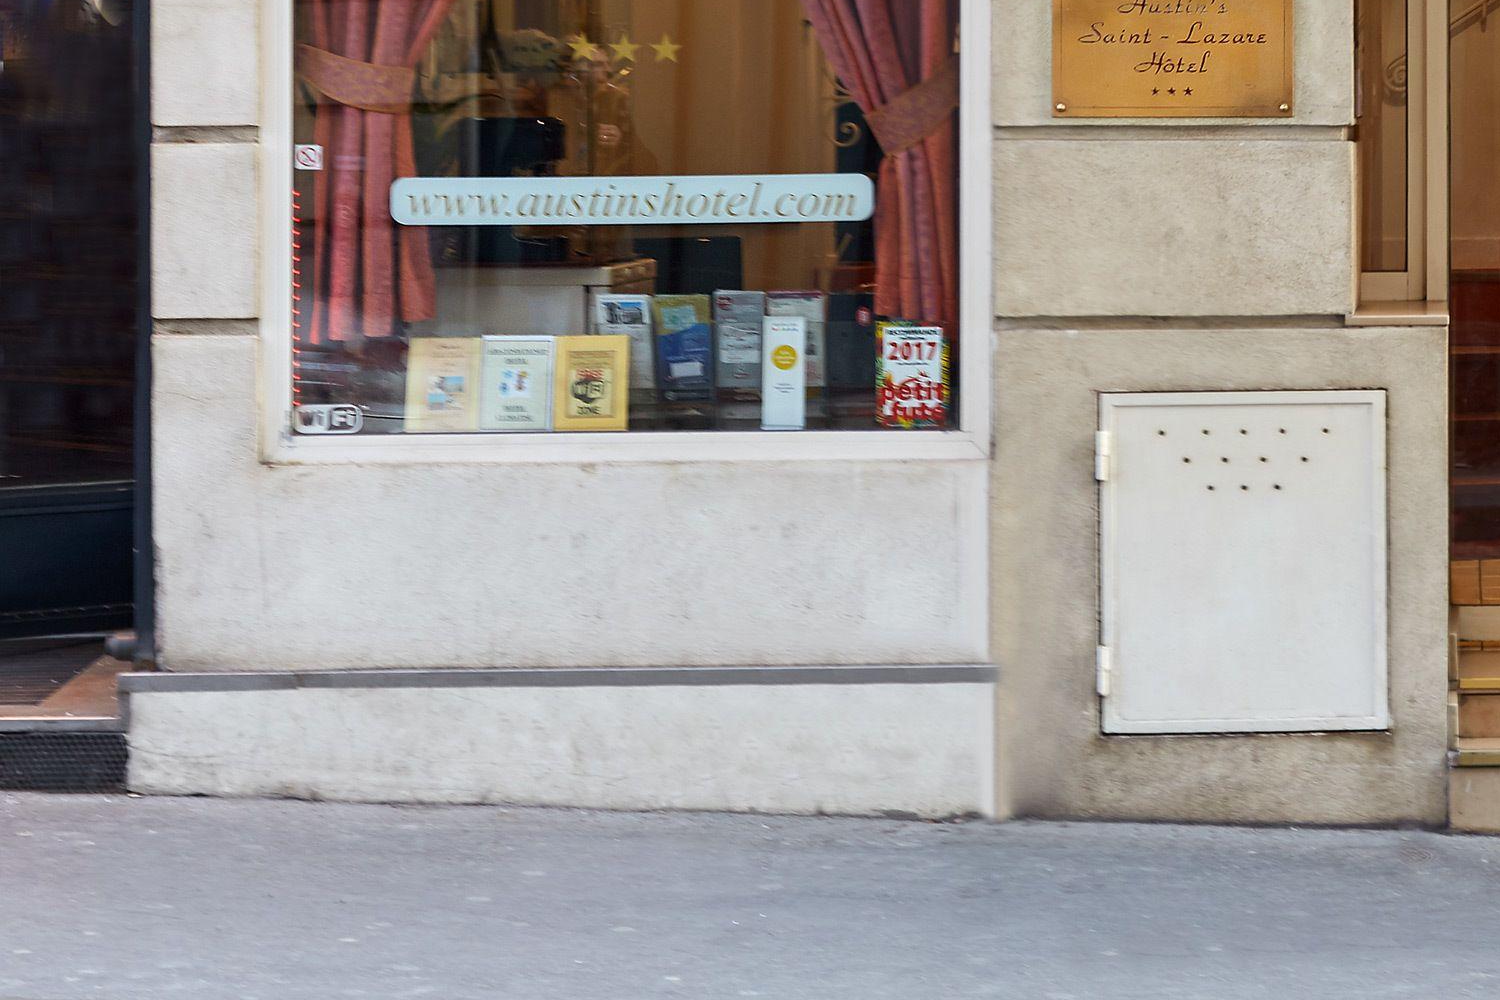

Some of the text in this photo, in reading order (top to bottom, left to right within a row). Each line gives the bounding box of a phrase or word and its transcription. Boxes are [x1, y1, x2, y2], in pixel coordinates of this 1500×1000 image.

[1077, 21, 1152, 45] Saint
[1176, 21, 1268, 45] Lazare
[1133, 50, 1212, 75] Hôtel
[406, 180, 857, 219] www.austinshotel.com
[888, 341, 937, 360] 2017
